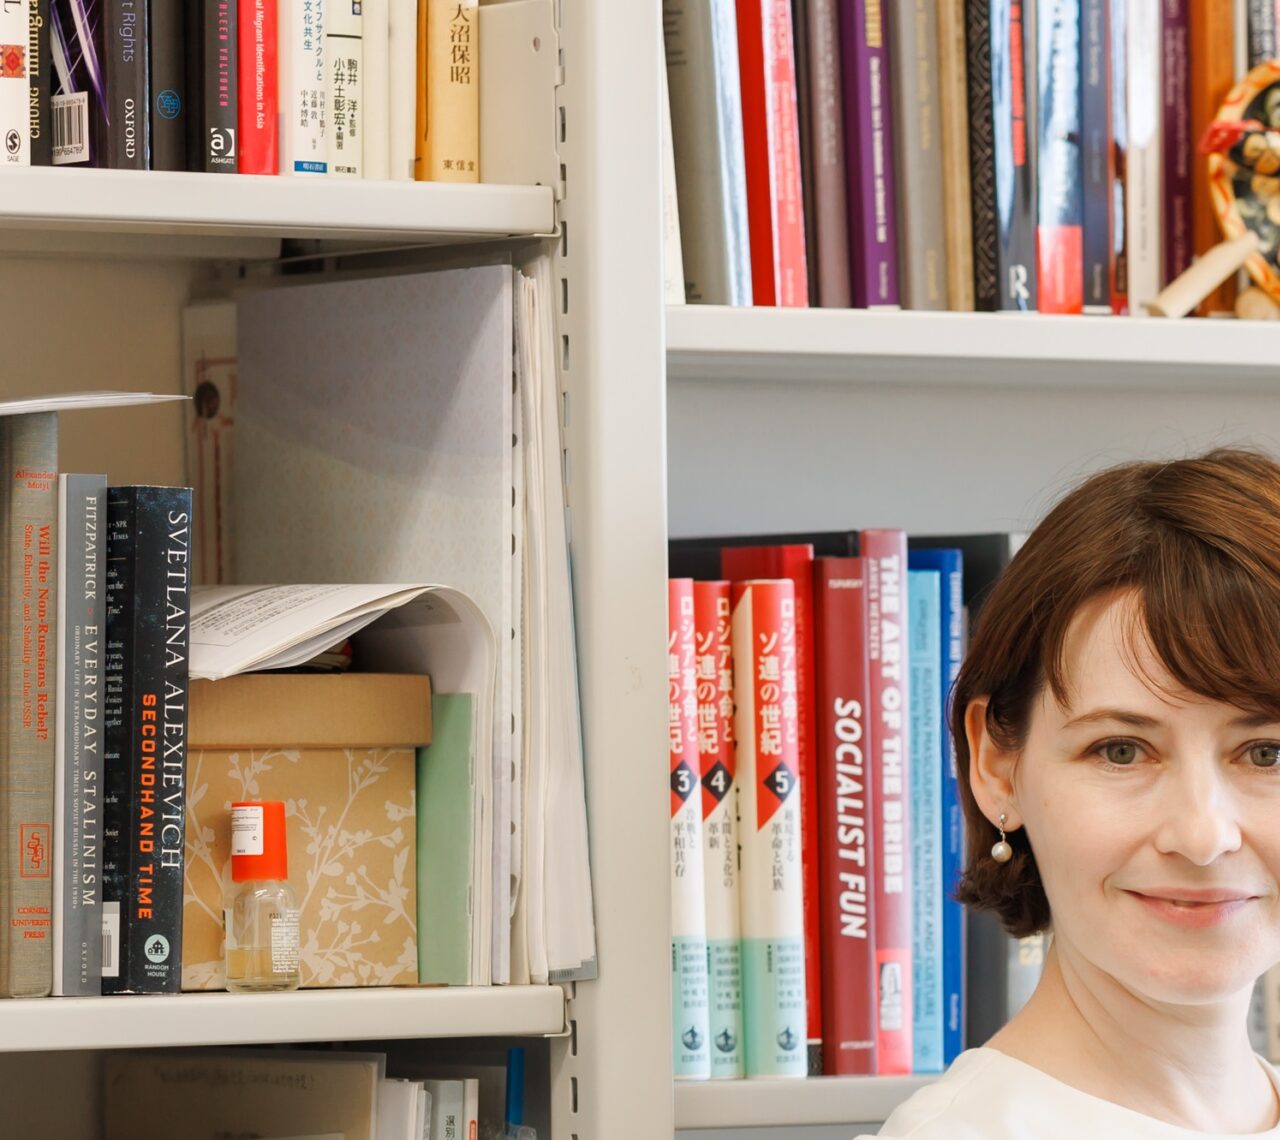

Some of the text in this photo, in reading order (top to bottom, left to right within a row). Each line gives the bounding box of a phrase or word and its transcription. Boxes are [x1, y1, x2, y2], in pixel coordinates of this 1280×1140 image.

[119, 12, 136, 63] Rights
[304, 1, 313, 51] 文化共生
[450, 3, 471, 85] 大沼保昭
[256, 10, 265, 129] Migrant Identifications in Asia
[333, 58, 346, 126] 小井土彰宏
[30, 87, 41, 139] CHUNG
[124, 98, 135, 159] OXFORD
[27, 481, 49, 490] Motyl
[115, 521, 127, 529] NPR
[22, 524, 33, 728] State, and Stability in the USSR
[36, 525, 50, 741] Will the Non-Russians Rebel?
[868, 557, 880, 660] JAMES HEINZEN
[74, 689, 80, 697] IN
[161, 510, 188, 870] SVETLANA ALEXIEVICH
[681, 596, 698, 742] ロシア革命と
[696, 597, 733, 755] ロシア革命と ソ連の世紀
[759, 598, 798, 755] ロシア革命と ソ連の世紀
[82, 496, 98, 906] FITZPATRICK EVERYDAY STALINISM
[881, 554, 904, 894] THE ART OF THE BRIDE
[137, 693, 157, 920] SECONDHAND TIME
[677, 770, 690, 792] 3
[710, 770, 726, 792] 4
[775, 770, 789, 793] 5
[834, 697, 867, 939] SOCIALIST FUN
[72, 858, 78, 867] IN
[924, 859, 935, 917] HISTORY
[12, 918, 53, 927] UNIVERSIT
[17, 907, 49, 915] CORNELL
[24, 930, 46, 939] PRESS
[924, 921, 935, 953] AND
[924, 957, 935, 1016] CULTURE
